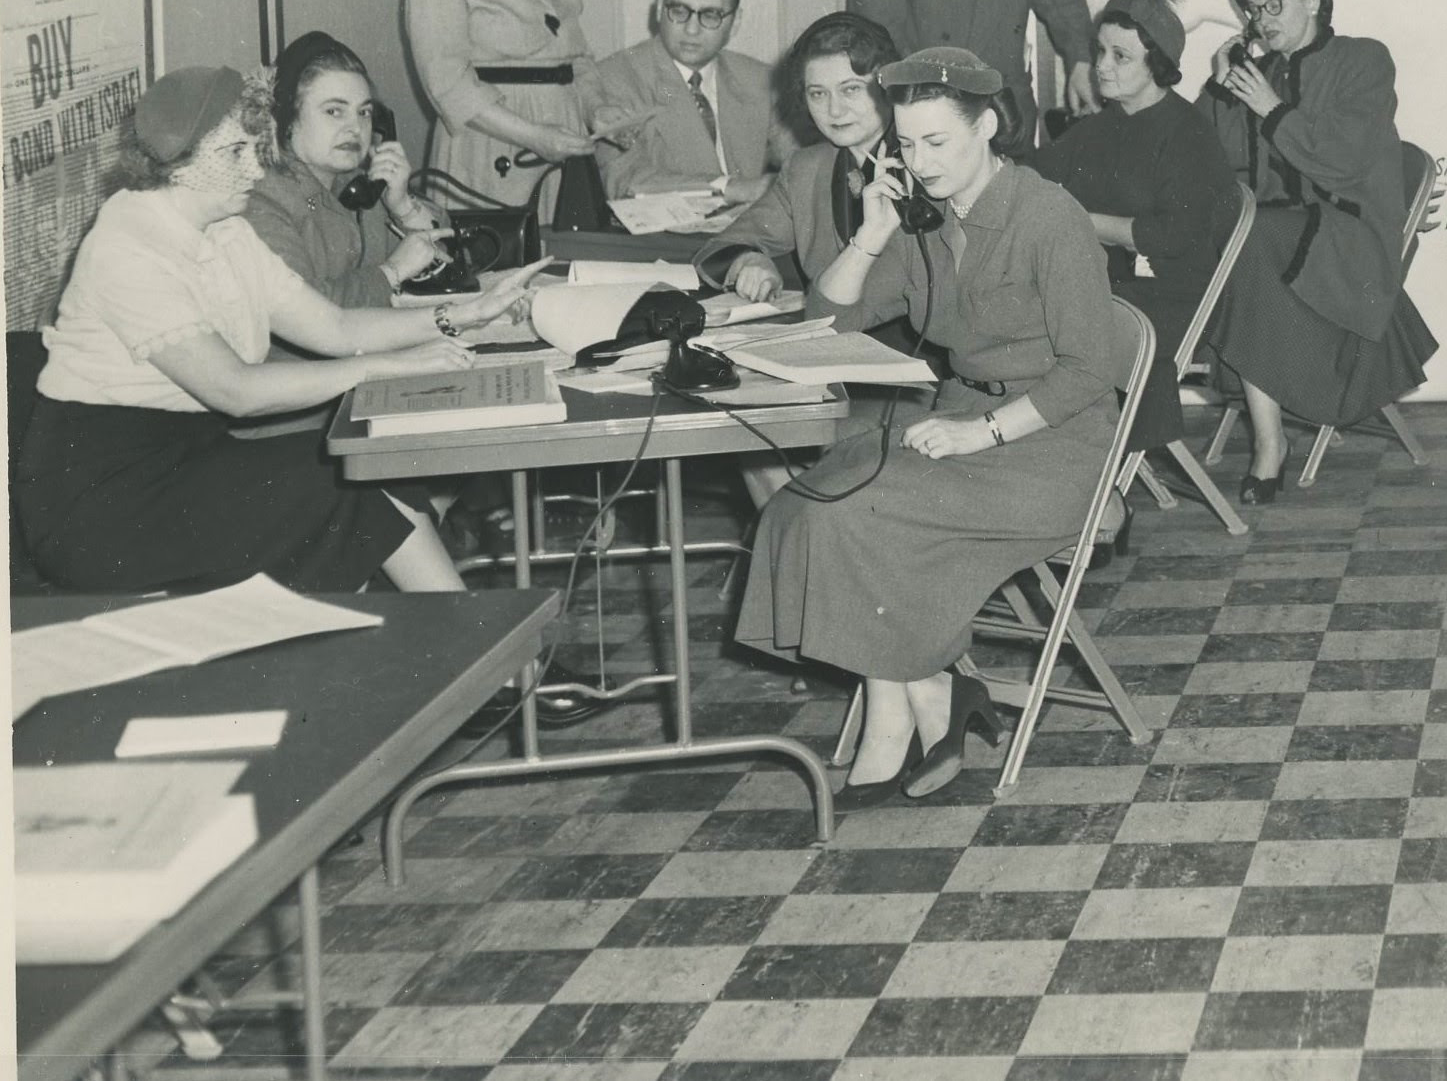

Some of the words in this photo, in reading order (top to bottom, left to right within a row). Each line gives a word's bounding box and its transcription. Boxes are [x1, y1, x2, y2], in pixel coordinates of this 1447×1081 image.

[27, 15, 74, 110] BUY
[11, 119, 55, 183] BOND
[57, 94, 97, 156] WITH
